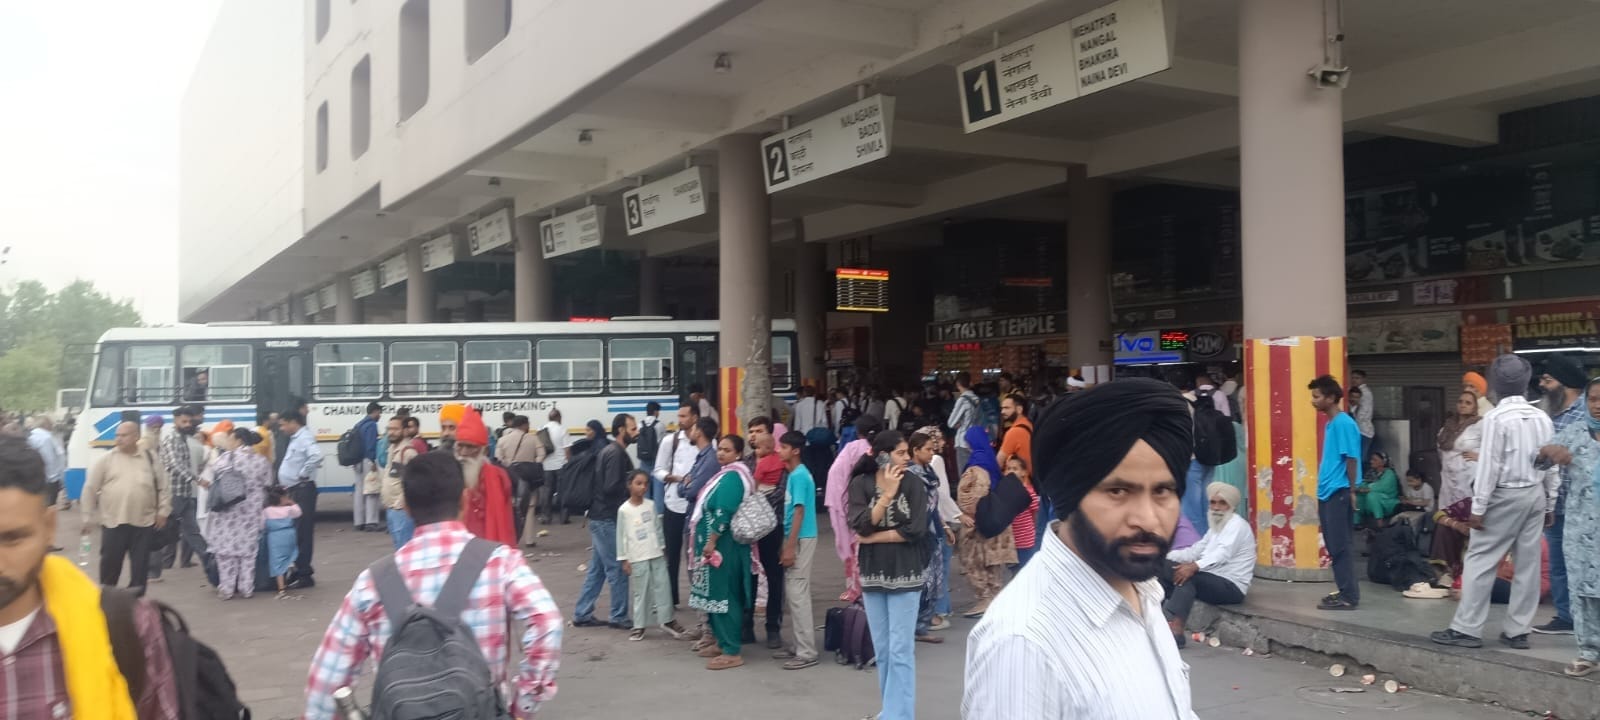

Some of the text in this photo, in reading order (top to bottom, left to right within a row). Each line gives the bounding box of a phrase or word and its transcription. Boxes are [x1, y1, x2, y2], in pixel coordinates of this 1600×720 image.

[1073, 13, 1118, 38] MEHATPUR
[1079, 33, 1118, 52] NANGAL
[1078, 47, 1119, 71] BHAKHRA
[1080, 62, 1128, 88] NAINA DEVI
[973, 70, 993, 112] 1
[770, 146, 785, 181] 2
[629, 199, 640, 225] 3
[544, 224, 554, 251] 4
[953, 320, 994, 339] TASTE
[1000, 315, 1056, 336] TEMPLE
[1515, 311, 1598, 338] RADHIKA
[323, 403, 395, 416] CHANDIRH
